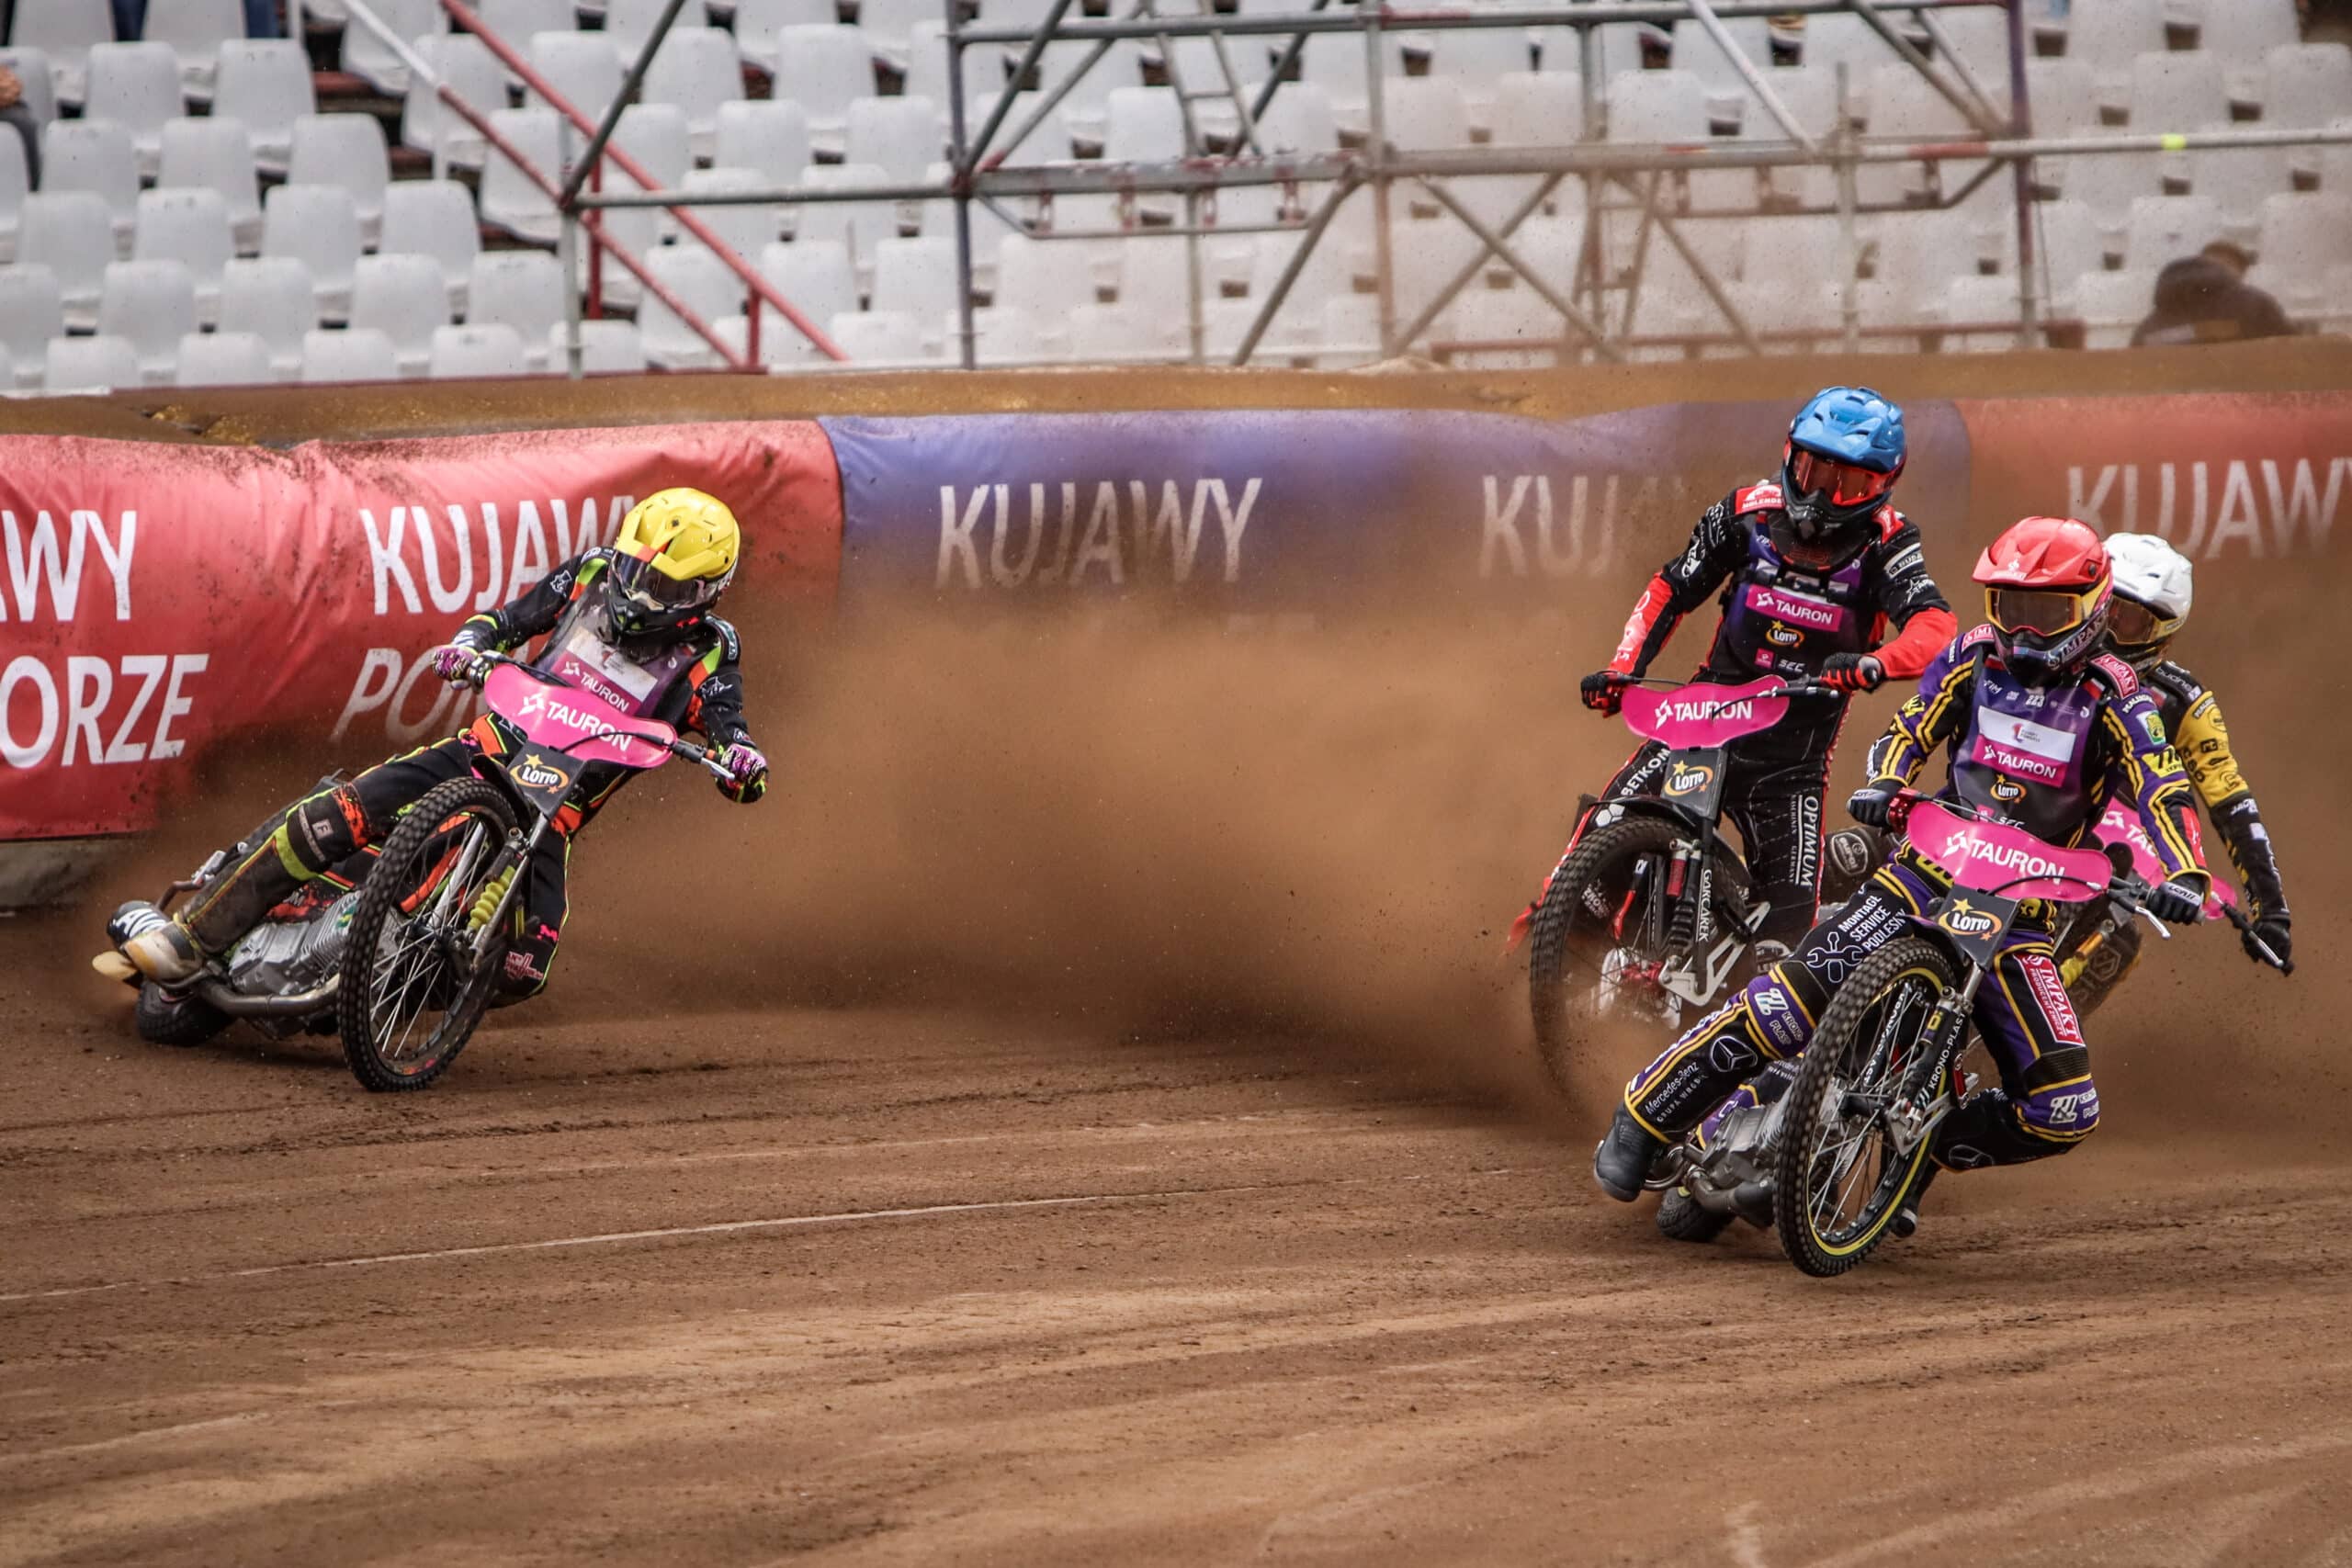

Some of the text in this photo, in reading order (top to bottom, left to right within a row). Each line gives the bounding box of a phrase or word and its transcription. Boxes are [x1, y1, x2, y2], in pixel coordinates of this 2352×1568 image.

[2068, 457, 2352, 558] KUJAW
[934, 478, 1262, 589] KUJAWY
[0, 510, 137, 622] WY
[358, 497, 636, 615] KUJAW
[1776, 600, 1833, 625] TAURON
[1773, 629, 1798, 642] LOTTO
[1779, 660, 1806, 673] SEC
[578, 671, 630, 713] TAURON
[1673, 701, 1753, 722] TAURON
[546, 701, 634, 752] TAURON
[521, 766, 559, 785] LOTTO
[1675, 772, 1705, 791] LOTTO
[1996, 751, 2057, 779] TAURON
[1997, 784, 2019, 797] LOTTO
[1799, 795, 1820, 887] OPTIMUM
[1970, 838, 2065, 886] TAURON
[1698, 868, 1713, 942] GARCAREK
[1838, 895, 1883, 933] MONTAGE
[1849, 906, 1892, 942] SERVICE
[1951, 916, 1992, 931] LOTTO
[2039, 967, 2079, 1042] IMPAKT
[1928, 1011, 1966, 1090] KRONO-PLAST
